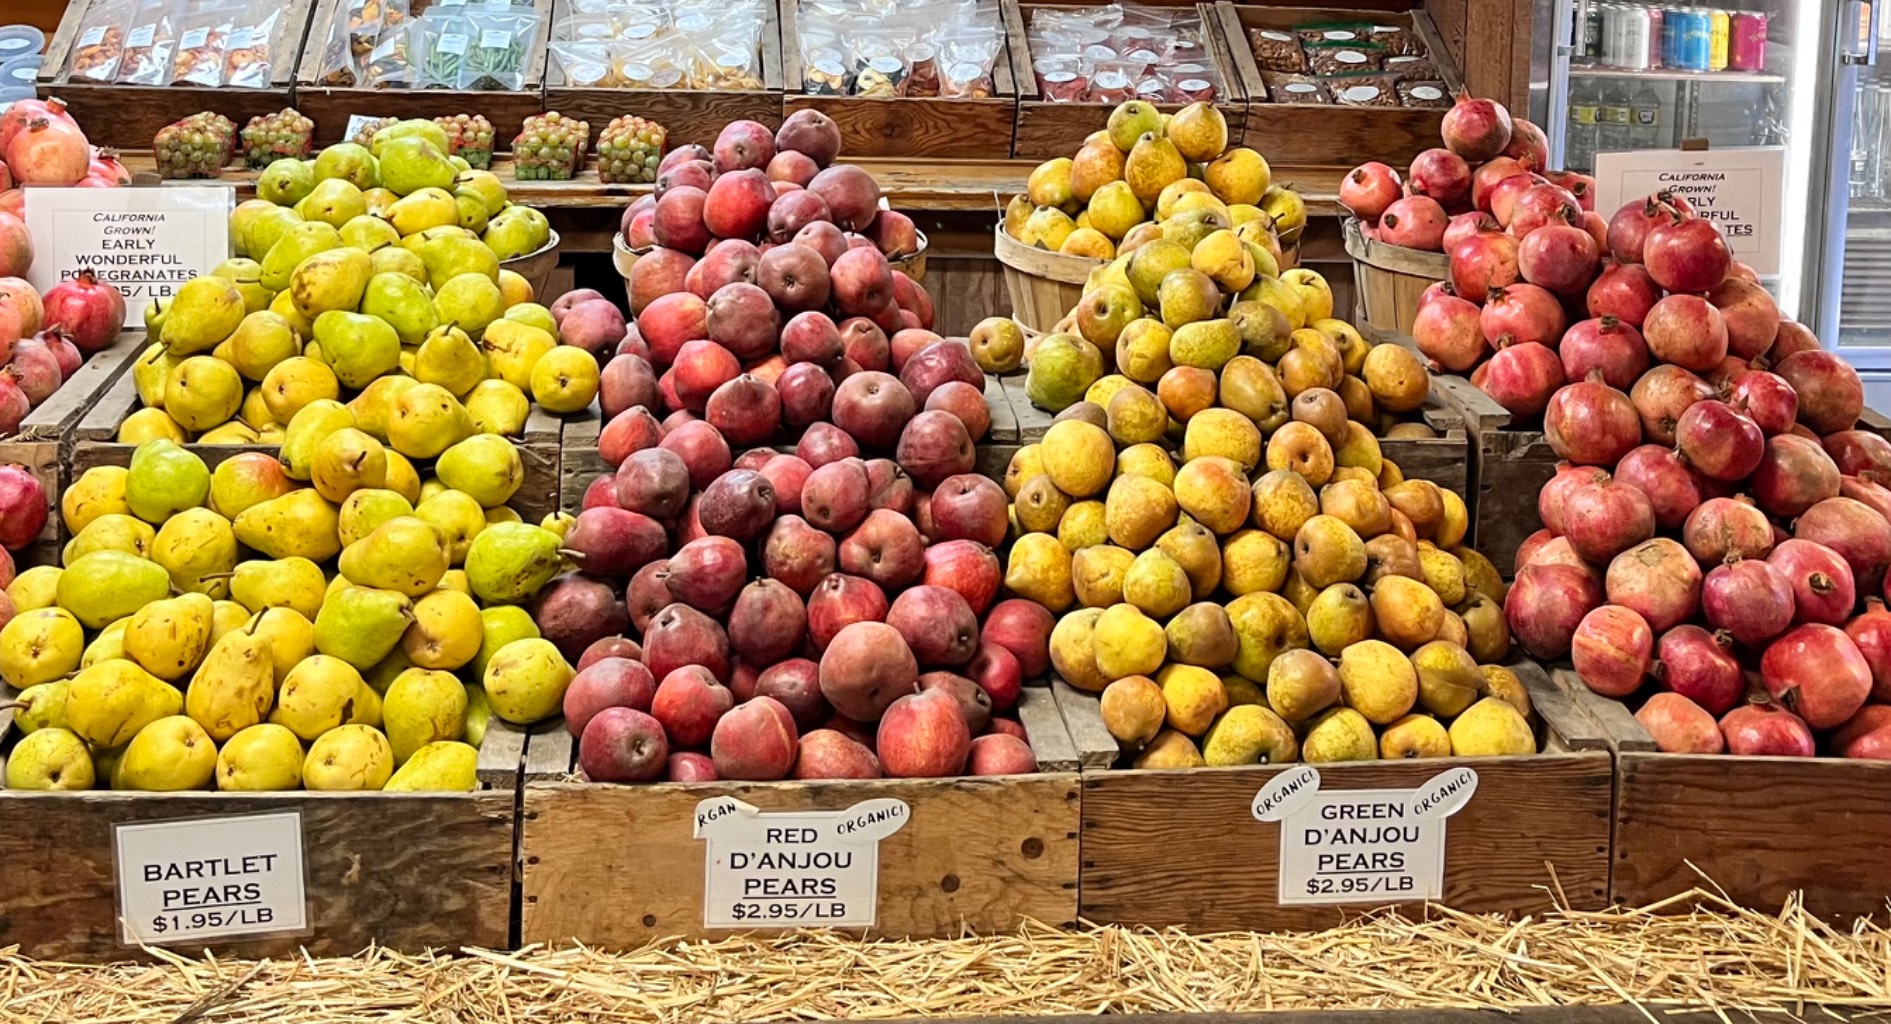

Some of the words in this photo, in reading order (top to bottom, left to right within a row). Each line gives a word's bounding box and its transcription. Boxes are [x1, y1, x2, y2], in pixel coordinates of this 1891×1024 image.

[1658, 172, 1726, 182] CALIFORNIA
[1669, 184, 1717, 194] GROWN!
[1687, 196, 1716, 207] RLY
[92, 212, 166, 223] CALIFORNIA
[103, 225, 156, 235] GROWN!
[102, 239, 156, 250] EARLY
[75, 254, 183, 265] WONDERFUL
[61, 269, 198, 280] POEGRANATES
[148, 285, 177, 297] LB.
[1255, 769, 1315, 816] ORGANIC!
[1413, 771, 1474, 816] ORGANIC!
[696, 802, 737, 828] RGAN
[836, 804, 905, 835] ORGANIC!
[1321, 802, 1404, 821] GREEN
[766, 828, 819, 843] RED
[1304, 826, 1420, 846] D'ANJOU
[143, 854, 278, 882] BARTLET
[730, 852, 852, 869] D'ANJOU
[1317, 852, 1405, 872] PEARS
[743, 878, 837, 896] PEARS
[1306, 876, 1414, 895] $2.95/LB
[162, 883, 263, 908] PEARS
[152, 907, 274, 933] $1.95/LB
[731, 902, 846, 920] $2.95/LB
